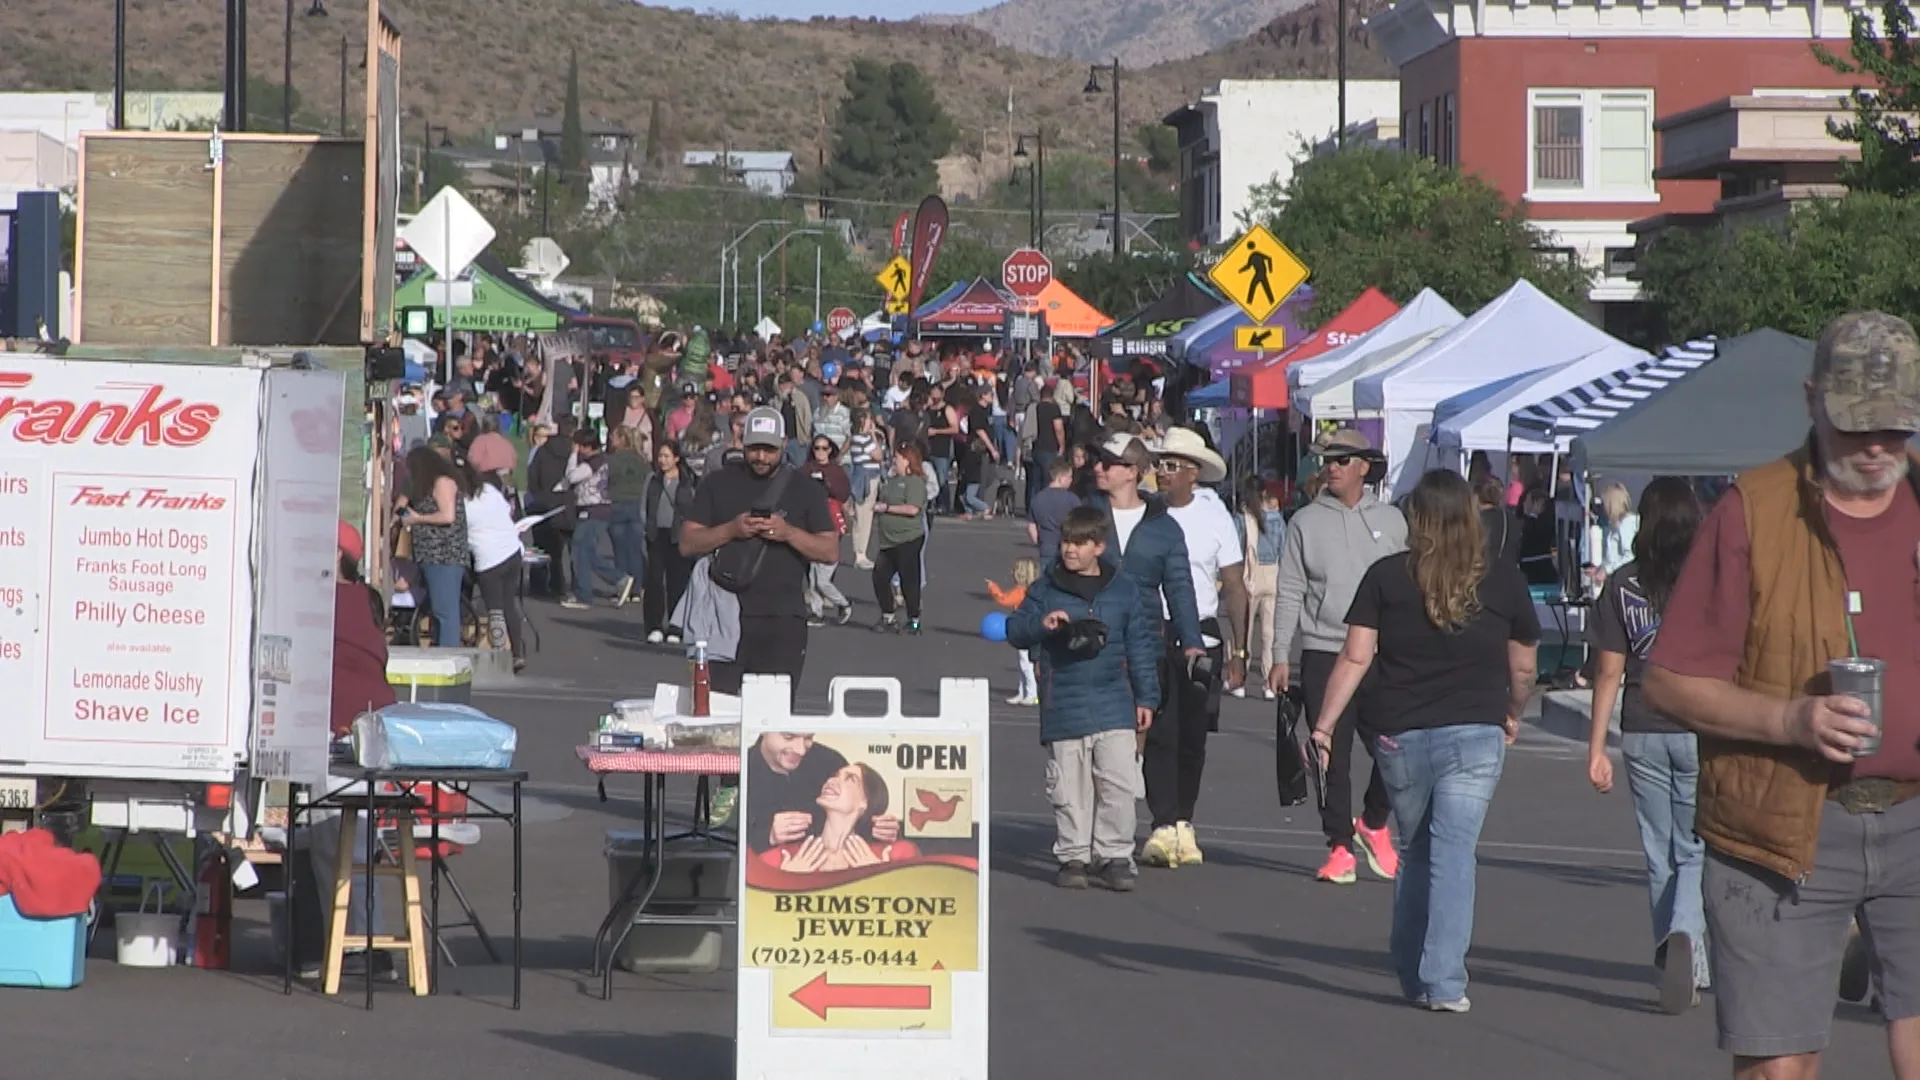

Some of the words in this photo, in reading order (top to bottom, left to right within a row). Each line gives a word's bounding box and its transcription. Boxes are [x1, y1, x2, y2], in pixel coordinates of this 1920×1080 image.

[1007, 264, 1048, 282] STOP
[460, 314, 531, 328] ANDERSEN
[830, 316, 854, 329] STOP
[0, 472, 28, 494] irs
[66, 485, 131, 509] Fast
[136, 487, 226, 511] Franks
[78, 525, 131, 547] Jumbo
[136, 527, 164, 548] Hot
[168, 528, 208, 554] Dogs
[76, 557, 126, 575] Franks
[131, 558, 164, 576] Foot
[168, 560, 207, 583] Long
[108, 575, 174, 596] Sausage
[75, 600, 126, 628] Philly
[132, 602, 205, 625] Cheese
[128, 642, 172, 654] available
[73, 667, 150, 690] Lemonade
[154, 670, 203, 697] Slushy
[74, 699, 149, 723] Shave
[163, 702, 200, 724] Ice
[868, 744, 892, 755] NOW
[896, 744, 967, 771] OPEN
[774, 894, 957, 917] BRIMSTONE
[792, 917, 933, 942] JEWELRY
[751, 947, 918, 967] (702)245-0444
